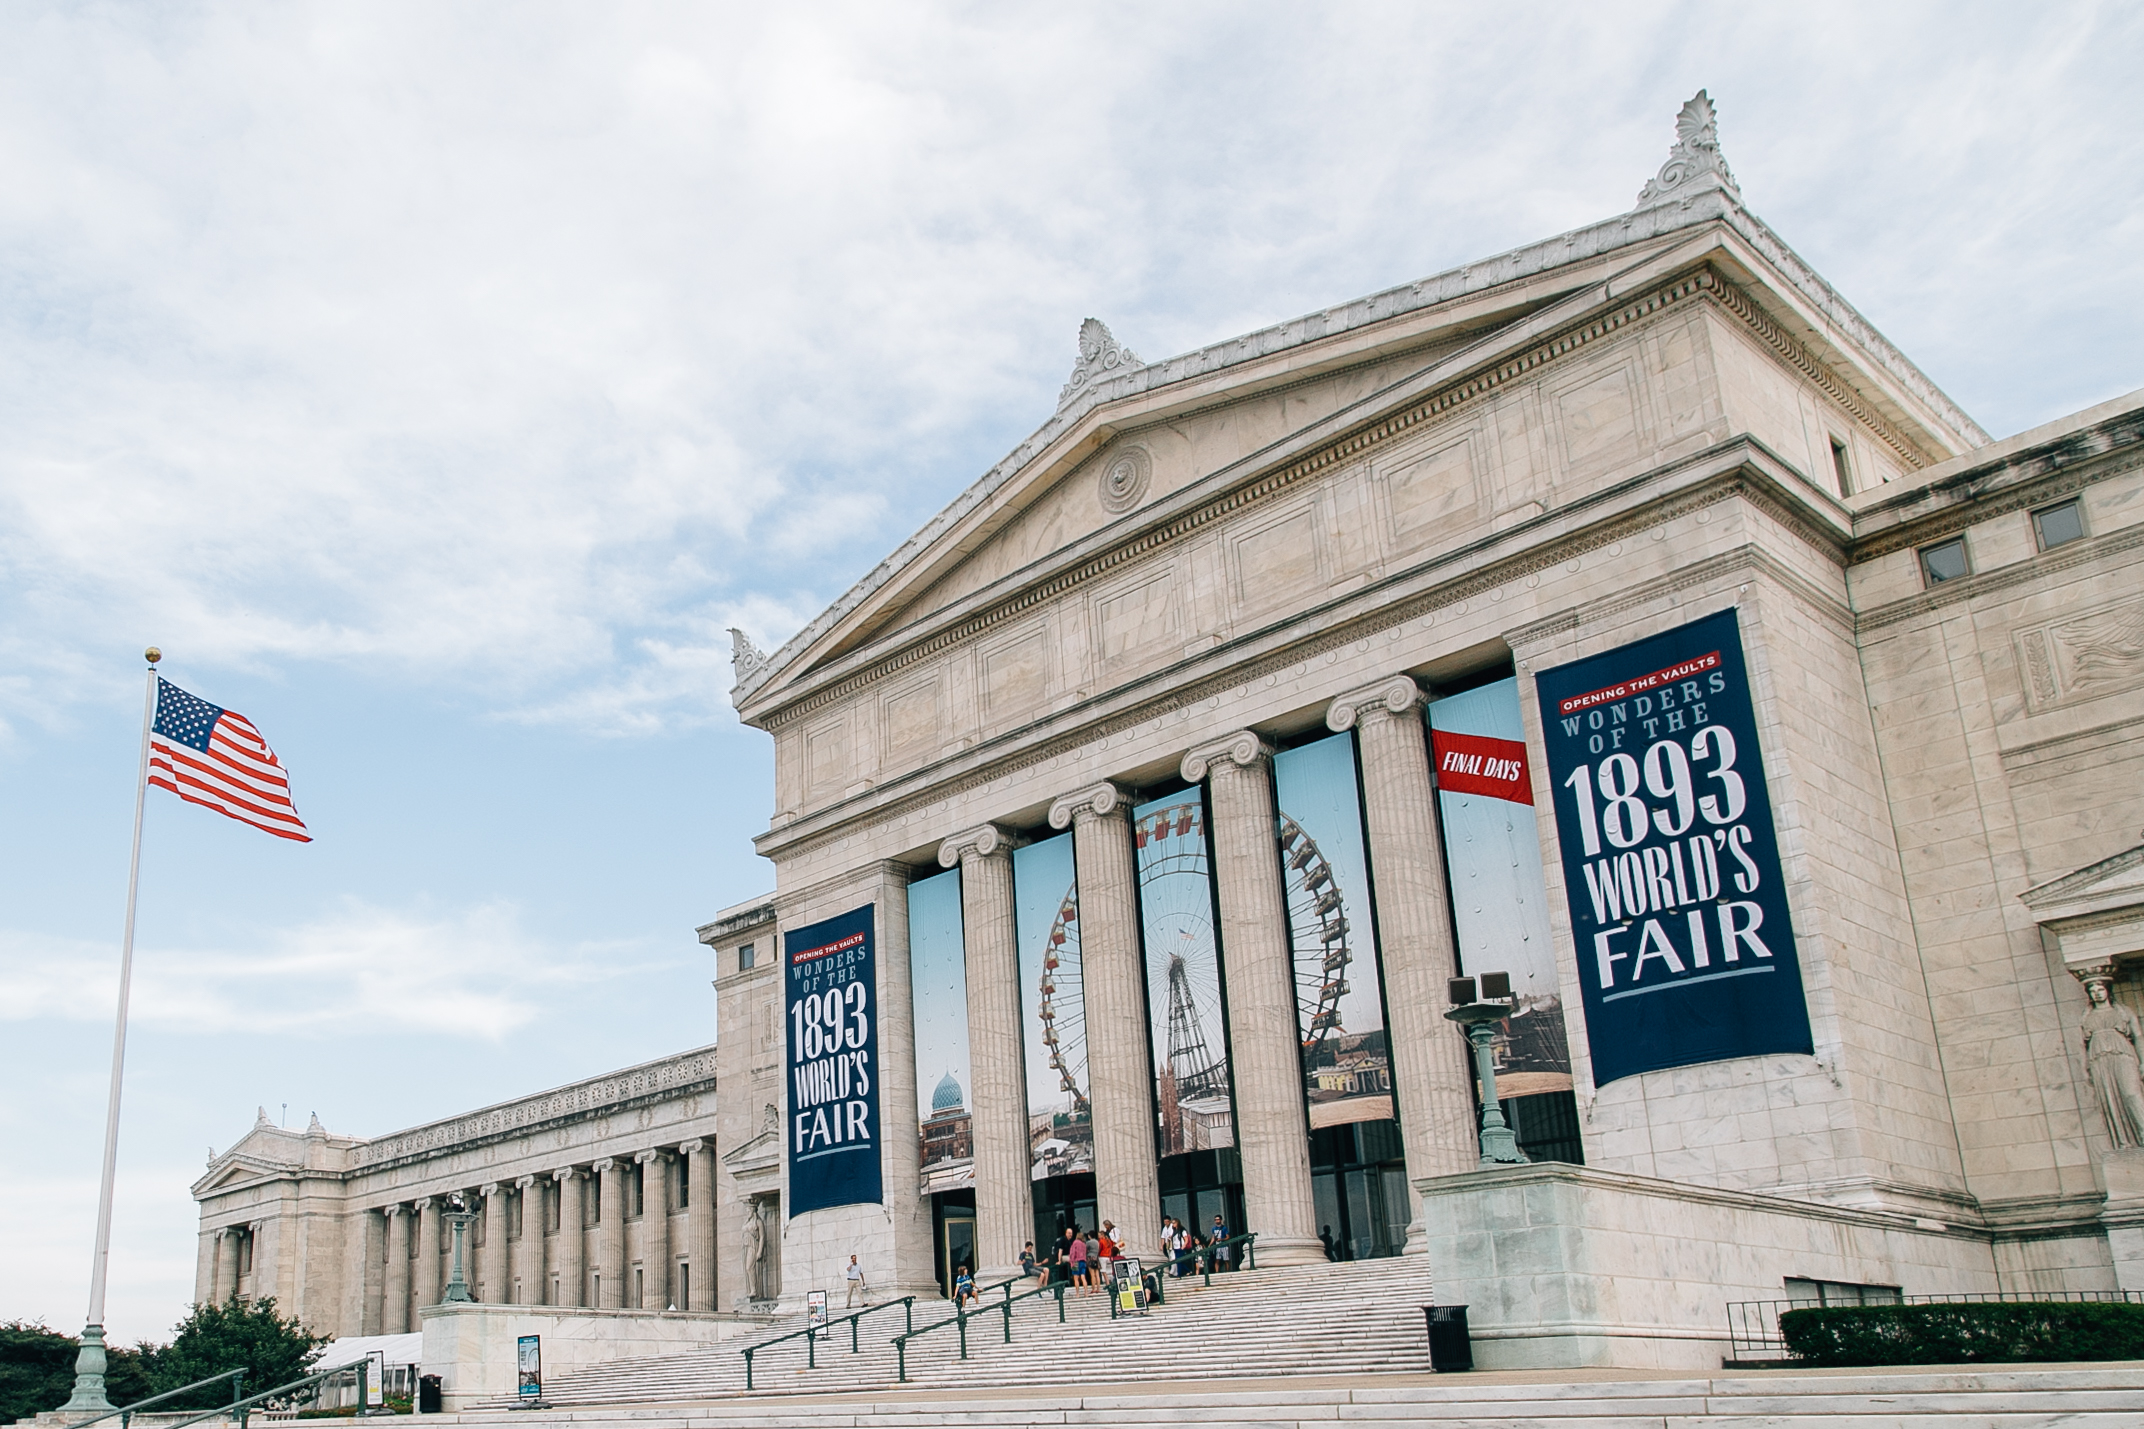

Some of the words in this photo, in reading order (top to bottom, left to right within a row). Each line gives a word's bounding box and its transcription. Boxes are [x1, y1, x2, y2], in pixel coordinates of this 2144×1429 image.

[1560, 671, 1725, 737] WONDERS
[1563, 687, 1625, 711] OPENING
[1630, 676, 1657, 691] THE
[1661, 656, 1716, 680] VAULTS
[1589, 727, 1625, 754] OF
[1643, 702, 1708, 739] THE
[1442, 751, 1482, 776] FINAL
[1483, 757, 1521, 781] DAYS
[1564, 725, 1746, 857] 1893
[1582, 824, 1760, 925] WORLD'S
[793, 945, 866, 980] WONDERS
[795, 949, 823, 961] OPENING
[825, 944, 838, 953] THE
[839, 934, 863, 948] VAULTS
[1594, 900, 1773, 989] FAIR
[803, 976, 820, 993] OF
[827, 965, 856, 986] THE
[791, 981, 868, 1063] 1893
[794, 1050, 869, 1109] WORLD'S
[796, 1100, 871, 1153] FAIR
